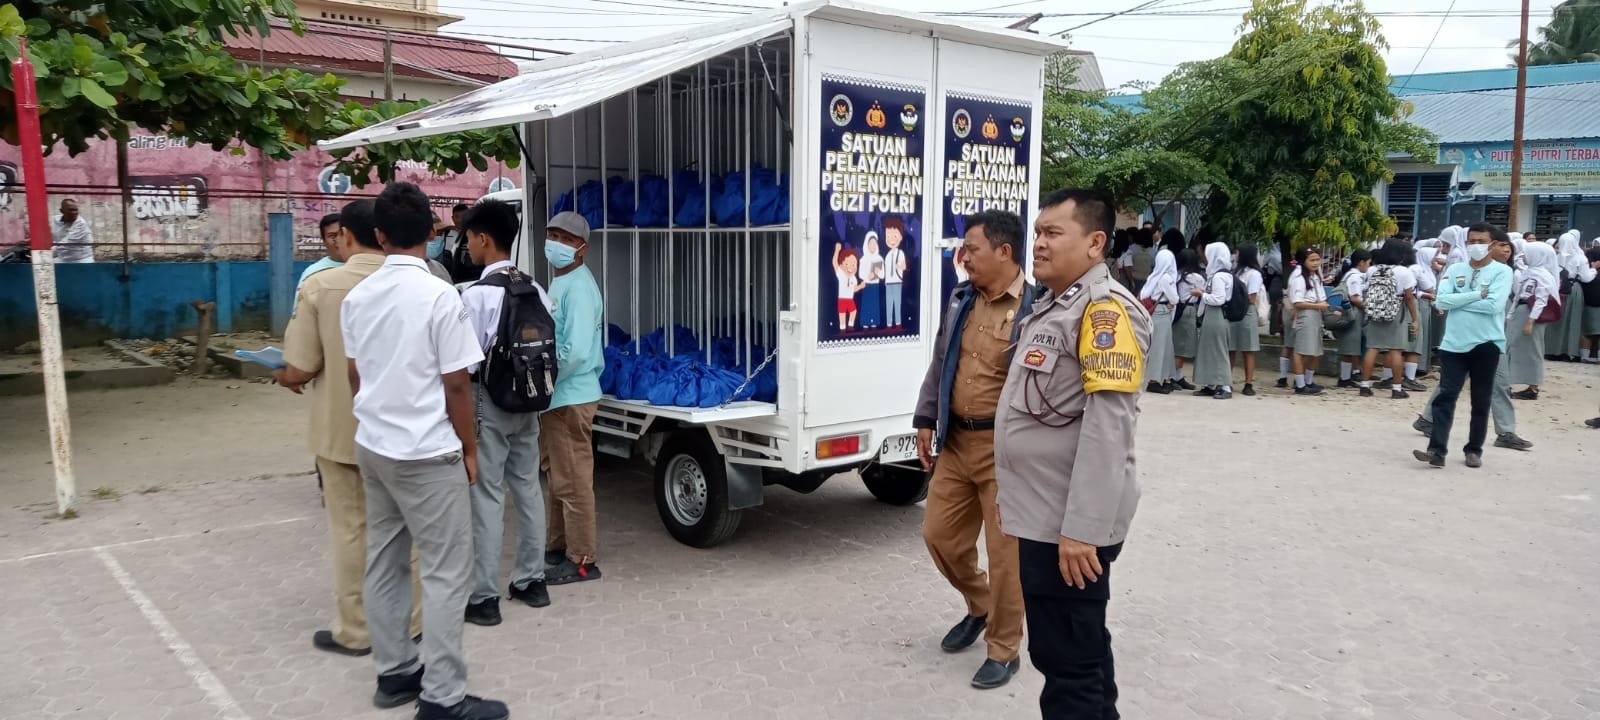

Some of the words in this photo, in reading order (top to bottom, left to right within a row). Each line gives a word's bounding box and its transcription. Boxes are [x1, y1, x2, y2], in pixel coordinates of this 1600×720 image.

[128, 135, 167, 150] aling
[842, 133, 906, 157] SATUAN
[826, 151, 920, 177] PELAYANAN
[961, 144, 1015, 165] SATUAN
[1491, 151, 1523, 161] PUT
[948, 160, 1027, 183] PELAYANAN
[822, 171, 923, 195] PEMENUHAN
[944, 177, 1029, 200] PEMENUHAN
[829, 192, 864, 213] GIZI
[868, 194, 915, 214] POLRI
[951, 197, 979, 215] GIZI
[983, 199, 1020, 216] POLRI
[1032, 334, 1056, 346] POLRI
[1096, 371, 1132, 382] TOMUAN
[882, 438, 889, 454] B
[899, 436, 917, 452] 979
